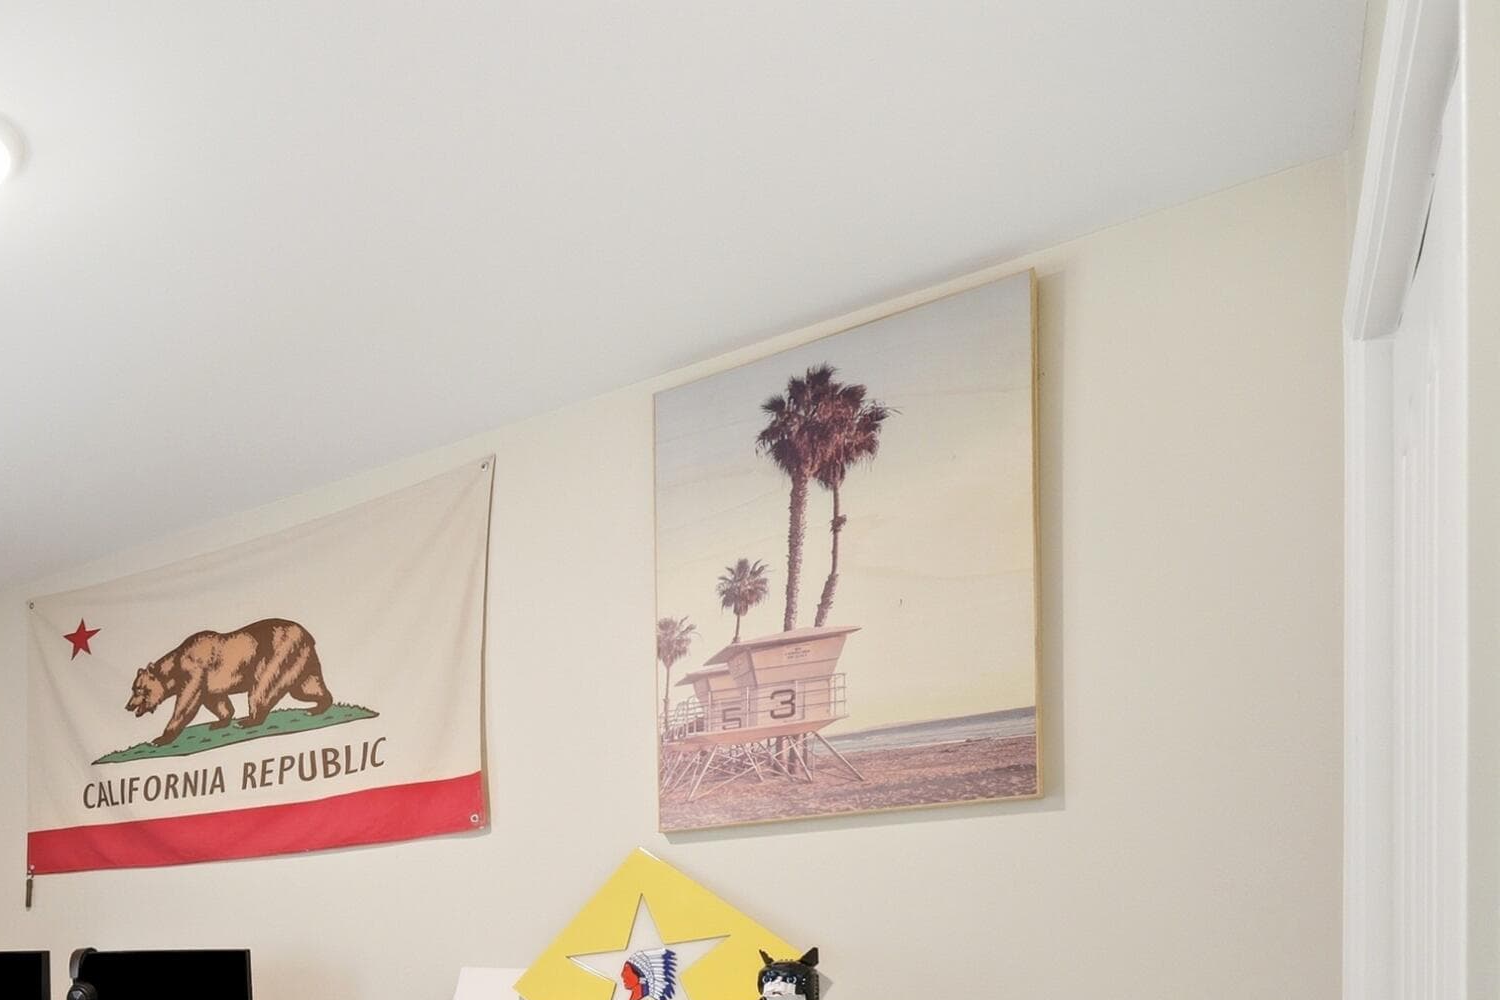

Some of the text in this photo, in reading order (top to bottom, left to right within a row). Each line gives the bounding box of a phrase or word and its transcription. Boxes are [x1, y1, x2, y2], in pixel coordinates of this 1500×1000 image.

[770, 688, 796, 719] 3
[82, 736, 387, 809] CALIFORNIA REPUBLIC
